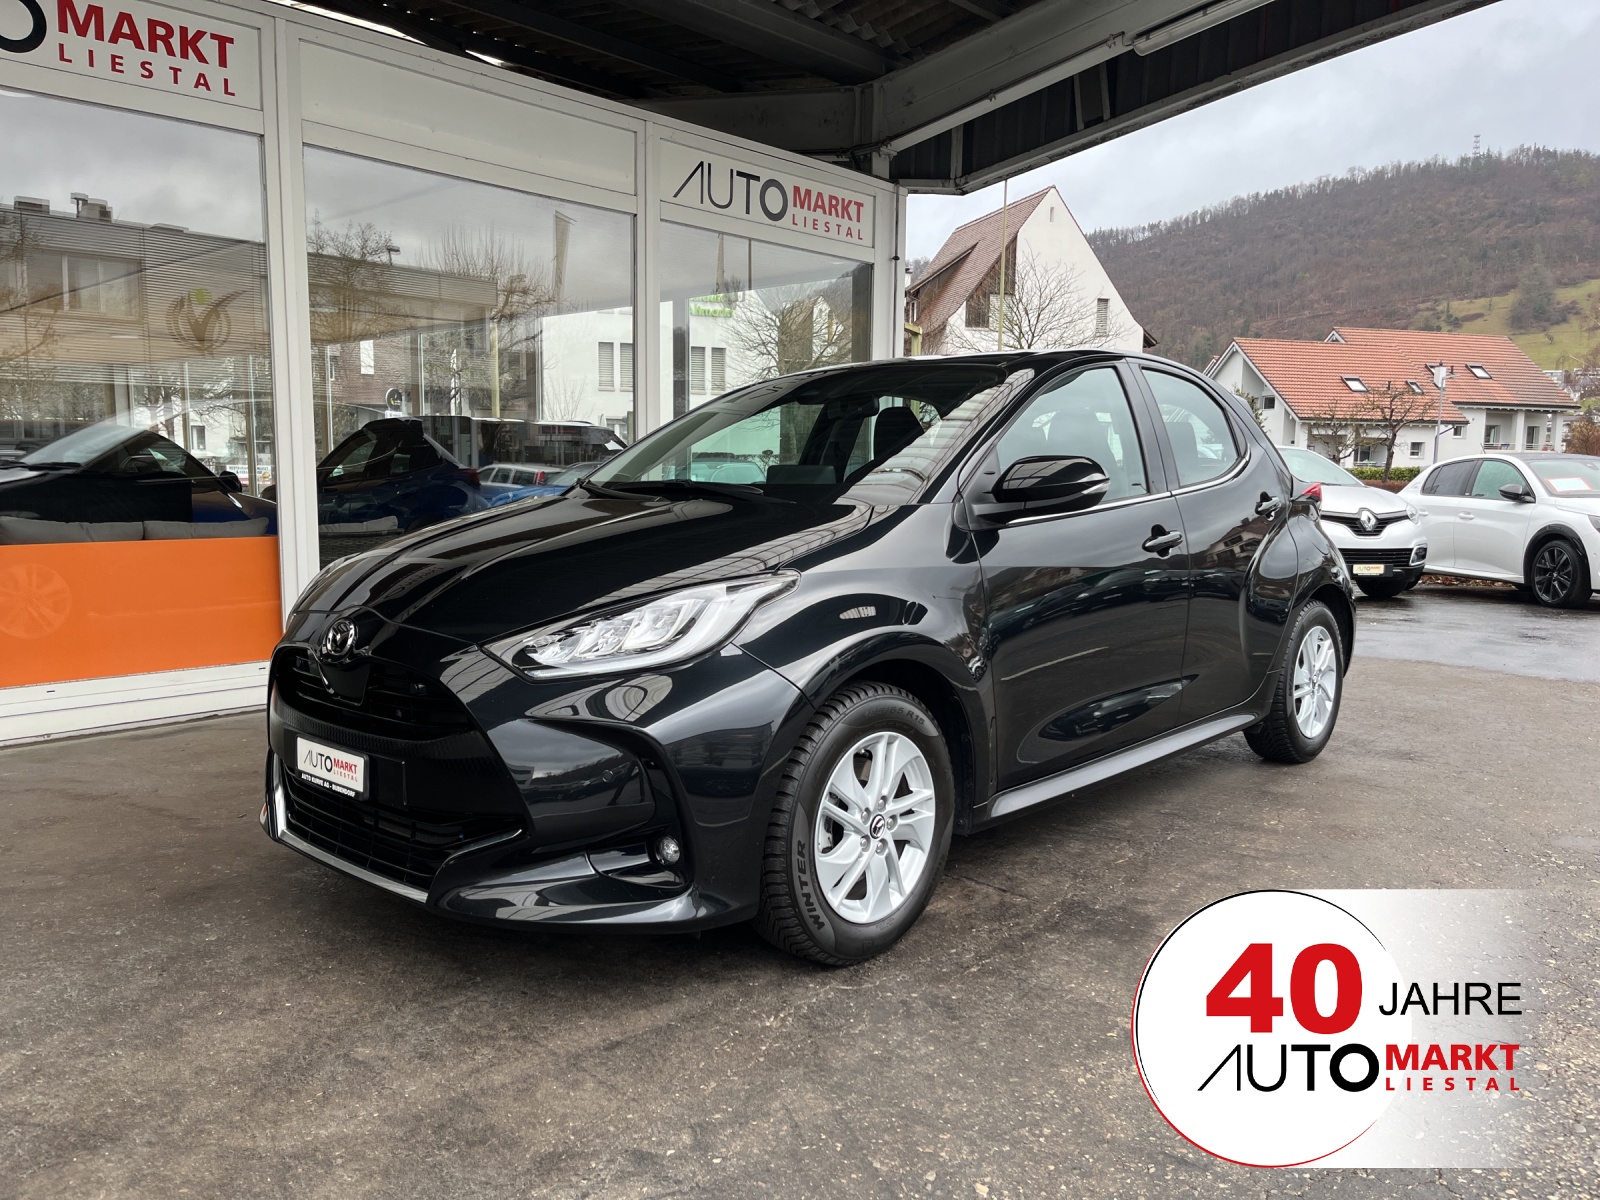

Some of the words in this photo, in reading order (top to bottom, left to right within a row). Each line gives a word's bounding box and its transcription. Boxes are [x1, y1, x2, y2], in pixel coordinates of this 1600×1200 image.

[57, 0, 235, 69] MARKT
[58, 42, 236, 97] LIESTAL
[672, 160, 789, 222] AUTO
[792, 185, 864, 223] MARKT
[792, 214, 863, 241] LIESTAL
[304, 750, 333, 773] AUTO
[333, 758, 357, 774] MARKT
[333, 770, 358, 782] LIESTAL
[797, 839, 826, 932] WINTER
